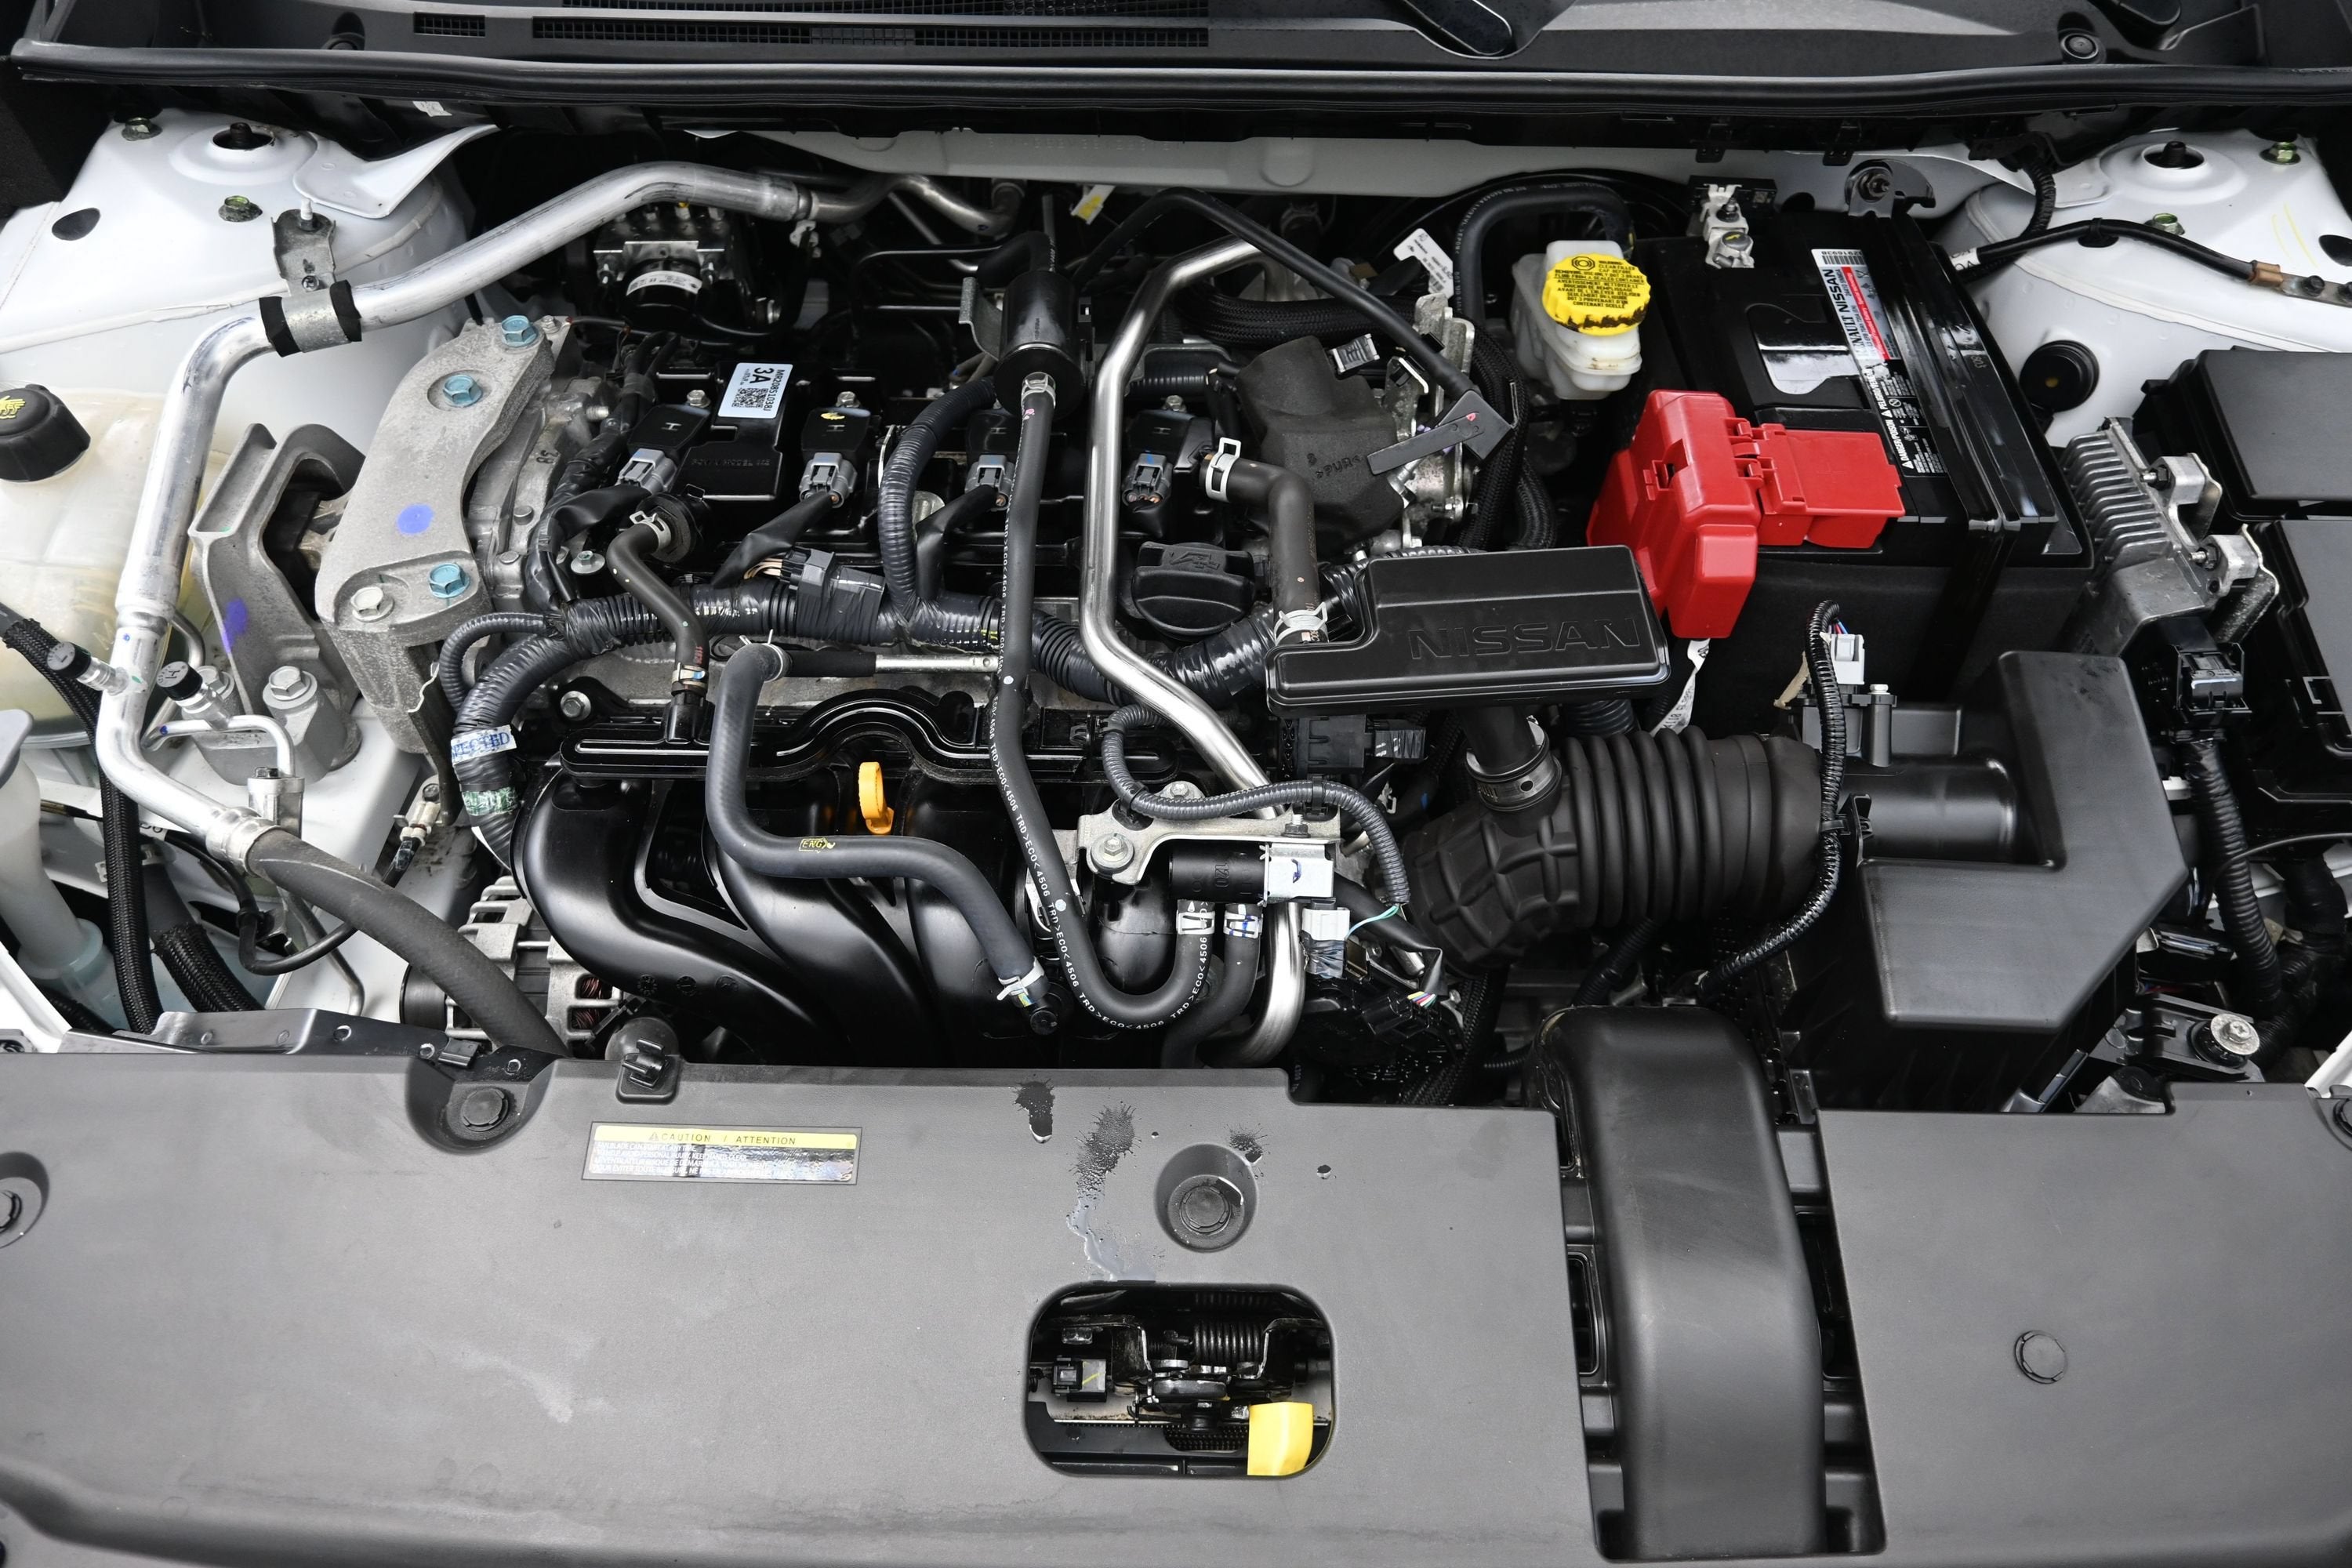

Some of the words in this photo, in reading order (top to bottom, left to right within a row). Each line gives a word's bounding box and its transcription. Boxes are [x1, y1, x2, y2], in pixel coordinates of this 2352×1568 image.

[1822, 269, 1850, 313] NISSAN
[1842, 315, 1868, 358] ENAULT
[750, 368, 775, 384] 3A
[1885, 419, 1910, 461] DANGER/POISON
[1408, 618, 1640, 659] NISSAN
[990, 742, 1018, 811] TRD>ECO<4506
[802, 840, 823, 849] ENG
[1016, 814, 1051, 897] TRD>ECO<4506
[1047, 902, 1079, 987] TRD>ECO<4506
[1170, 937, 1207, 1019] TRD>ECO<4506
[1079, 993, 1164, 1029] TRD>ECO<4506
[661, 1134, 710, 1142] CAUTION
[735, 1135, 796, 1145] ATTENTION
